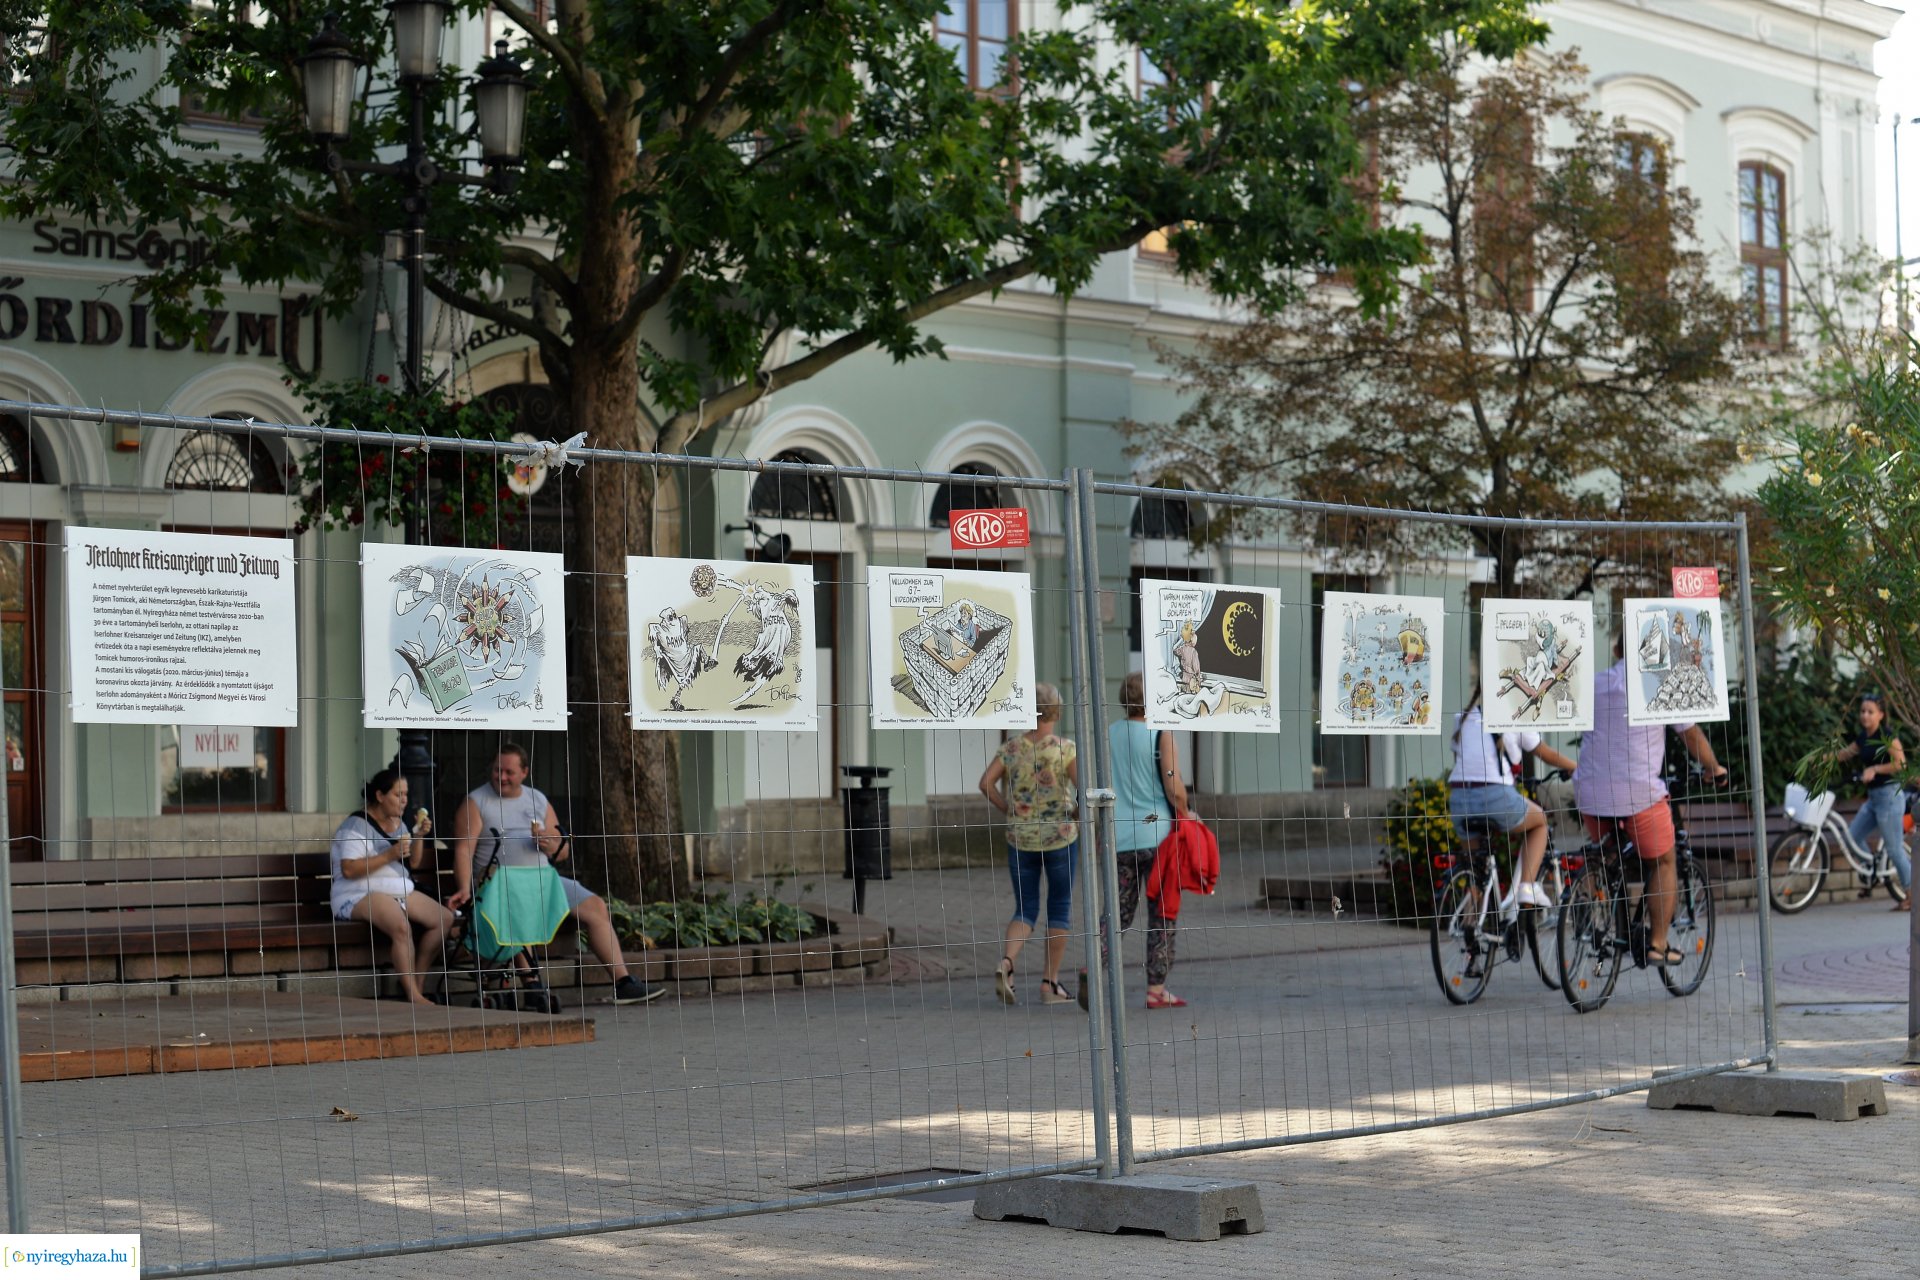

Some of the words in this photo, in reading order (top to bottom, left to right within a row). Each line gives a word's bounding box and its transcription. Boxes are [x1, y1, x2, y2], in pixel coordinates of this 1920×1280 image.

[33, 220, 229, 269] Samsonit
[957, 516, 1002, 542] EKRO
[142, 548, 215, 576] Kreisanzeiger
[217, 553, 238, 574] und
[239, 553, 280, 580] Zeitung
[1677, 573, 1702, 594] EKRO
[118, 584, 153, 592] nyelvterület
[154, 586, 170, 594] egyik
[171, 586, 207, 595] legnevesebb
[208, 588, 248, 598] karikaturistája
[92, 595, 112, 604] Jürgen
[112, 596, 138, 604] Tomicek,
[149, 597, 198, 607] Németországban,
[94, 607, 134, 616] tartományban
[143, 609, 179, 618] Nyíregyháza
[119, 620, 159, 629] tartománybeli
[160, 621, 185, 630] Iserlohn,
[211, 623, 232, 632] napilap
[124, 632, 162, 641] Kreisanzeiger
[176, 634, 197, 643] Zeitung
[198, 634, 213, 642] (IKZ),
[214, 635, 242, 643] amelyben
[139, 644, 152, 652] napi
[153, 645, 191, 653] eseményekre
[223, 647, 248, 655] jelennek
[120, 655, 169, 663] humoros-ironikus
[170, 657, 187, 665] rajzai.
[134, 667, 162, 676] válogatás
[163, 668, 181, 676] (2020.
[182, 669, 224, 678] március-június)
[225, 670, 245, 678] témája
[150, 679, 173, 688] járvány.
[253, 682, 274, 691] újságot
[120, 691, 163, 700] adományaként
[189, 693, 217, 702] Zsigmond
[218, 694, 240, 702] Megyei
[97, 703, 135, 712] Könyvtárban
[142, 704, 186, 713] megtalálhatják.
[195, 730, 240, 752] NYÍLIK!
